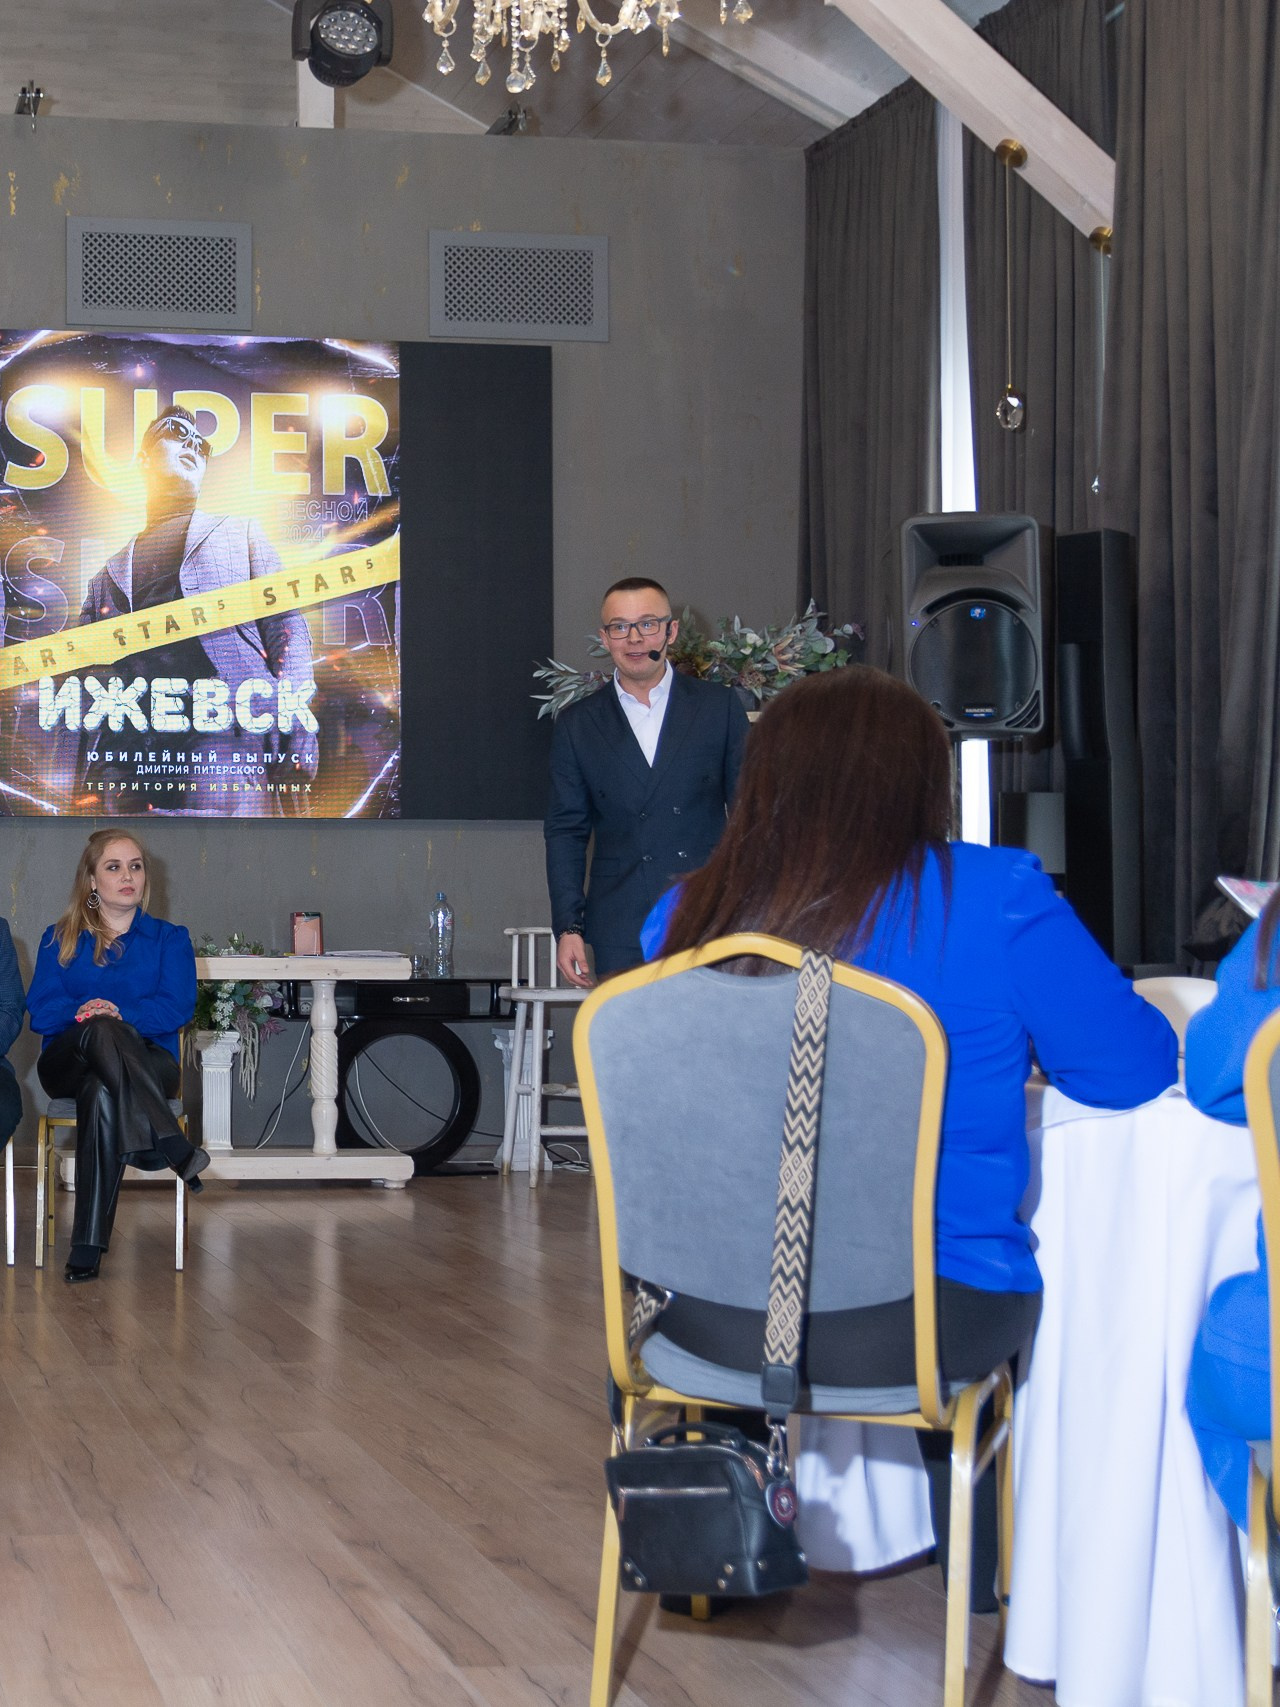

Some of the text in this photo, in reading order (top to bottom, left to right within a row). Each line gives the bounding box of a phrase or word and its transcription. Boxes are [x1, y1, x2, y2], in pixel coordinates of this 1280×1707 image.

[4, 384, 393, 496] SUPER
[38, 675, 320, 734] ИЖЕВСК
[86, 749, 314, 764] ЮБИЛЕЙНЫЙ ВЫПУСК
[136, 764, 266, 776] ДМИТРИЯ ПИТЕРСКОГО
[86, 781, 312, 793] ТЕРРИТОРИЯ ИЗБРАННЫХ
